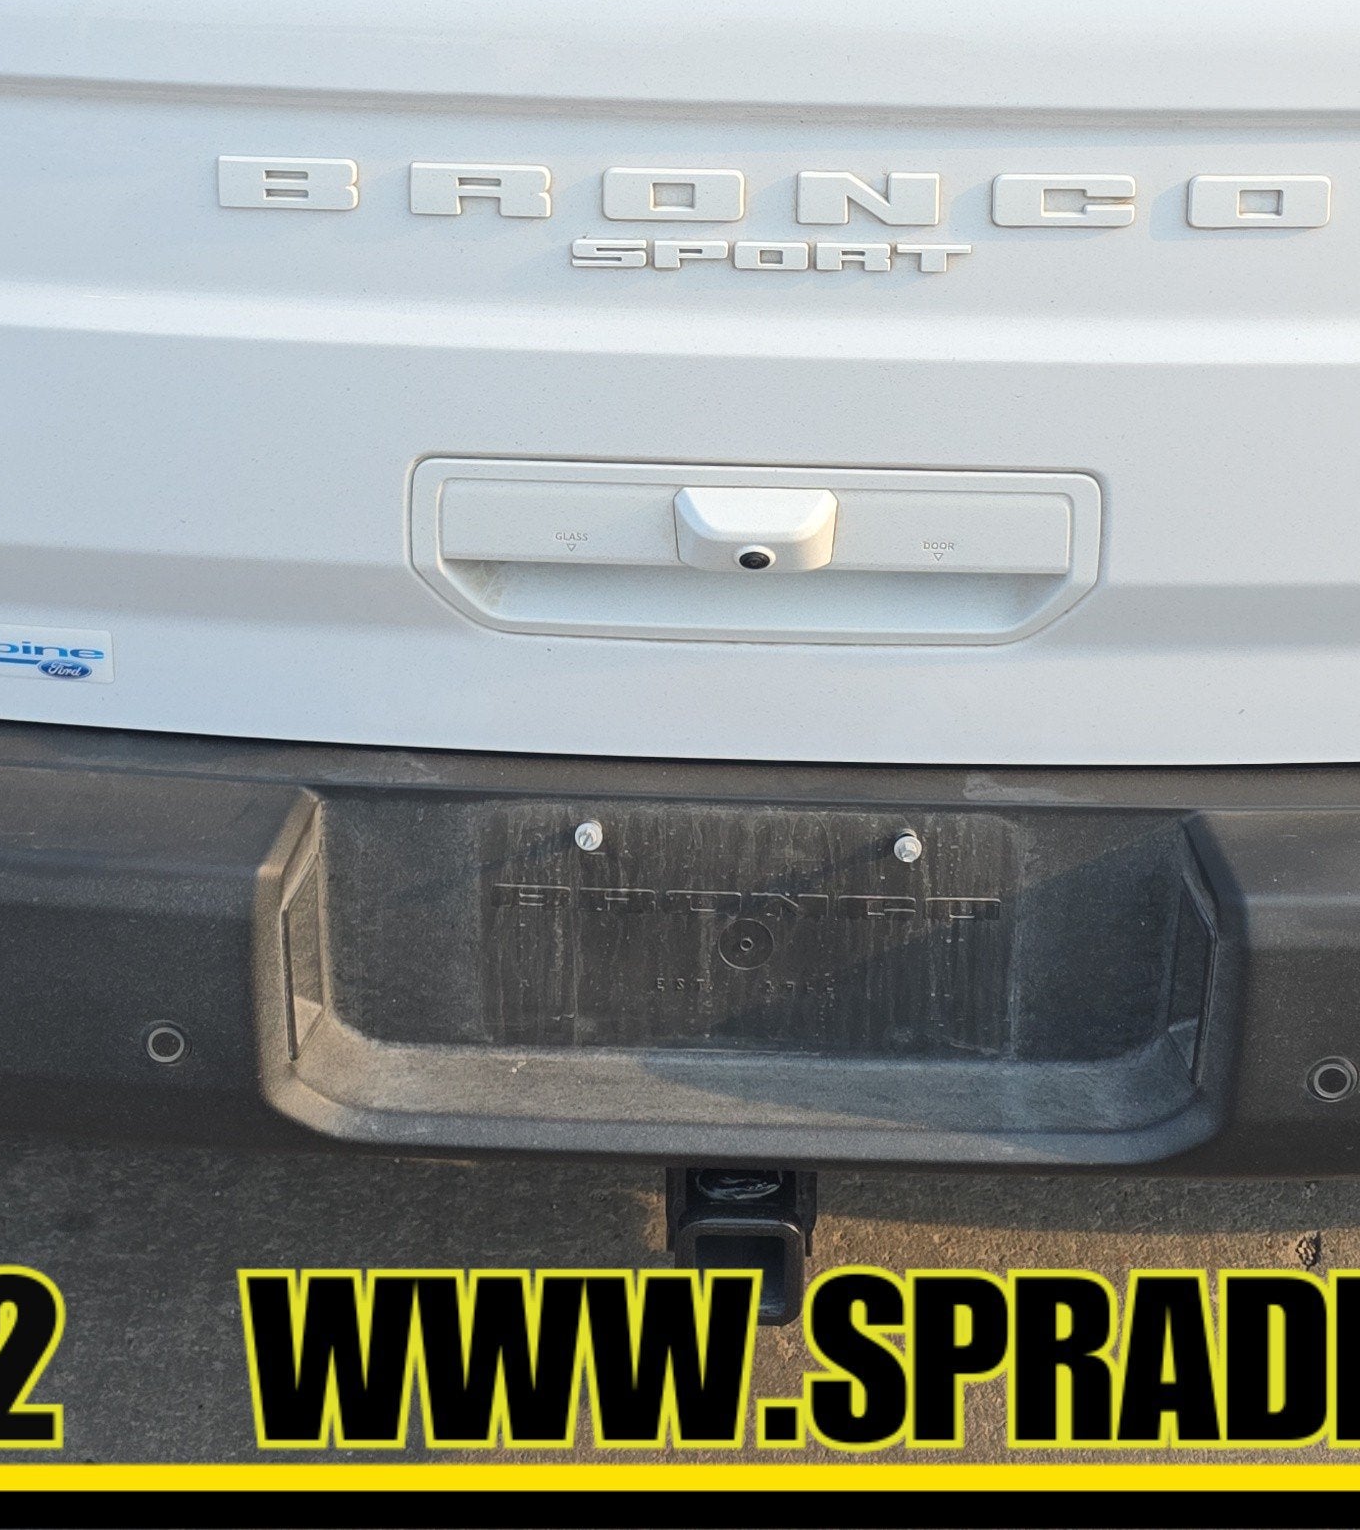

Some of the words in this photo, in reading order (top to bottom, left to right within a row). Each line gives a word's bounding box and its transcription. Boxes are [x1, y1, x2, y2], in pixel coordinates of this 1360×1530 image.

[216, 155, 1332, 229] BRONCO
[570, 237, 973, 273] SPORT
[554, 532, 588, 541] GLASS
[923, 542, 955, 550] DOOR
[47, 660, 83, 678] Ford
